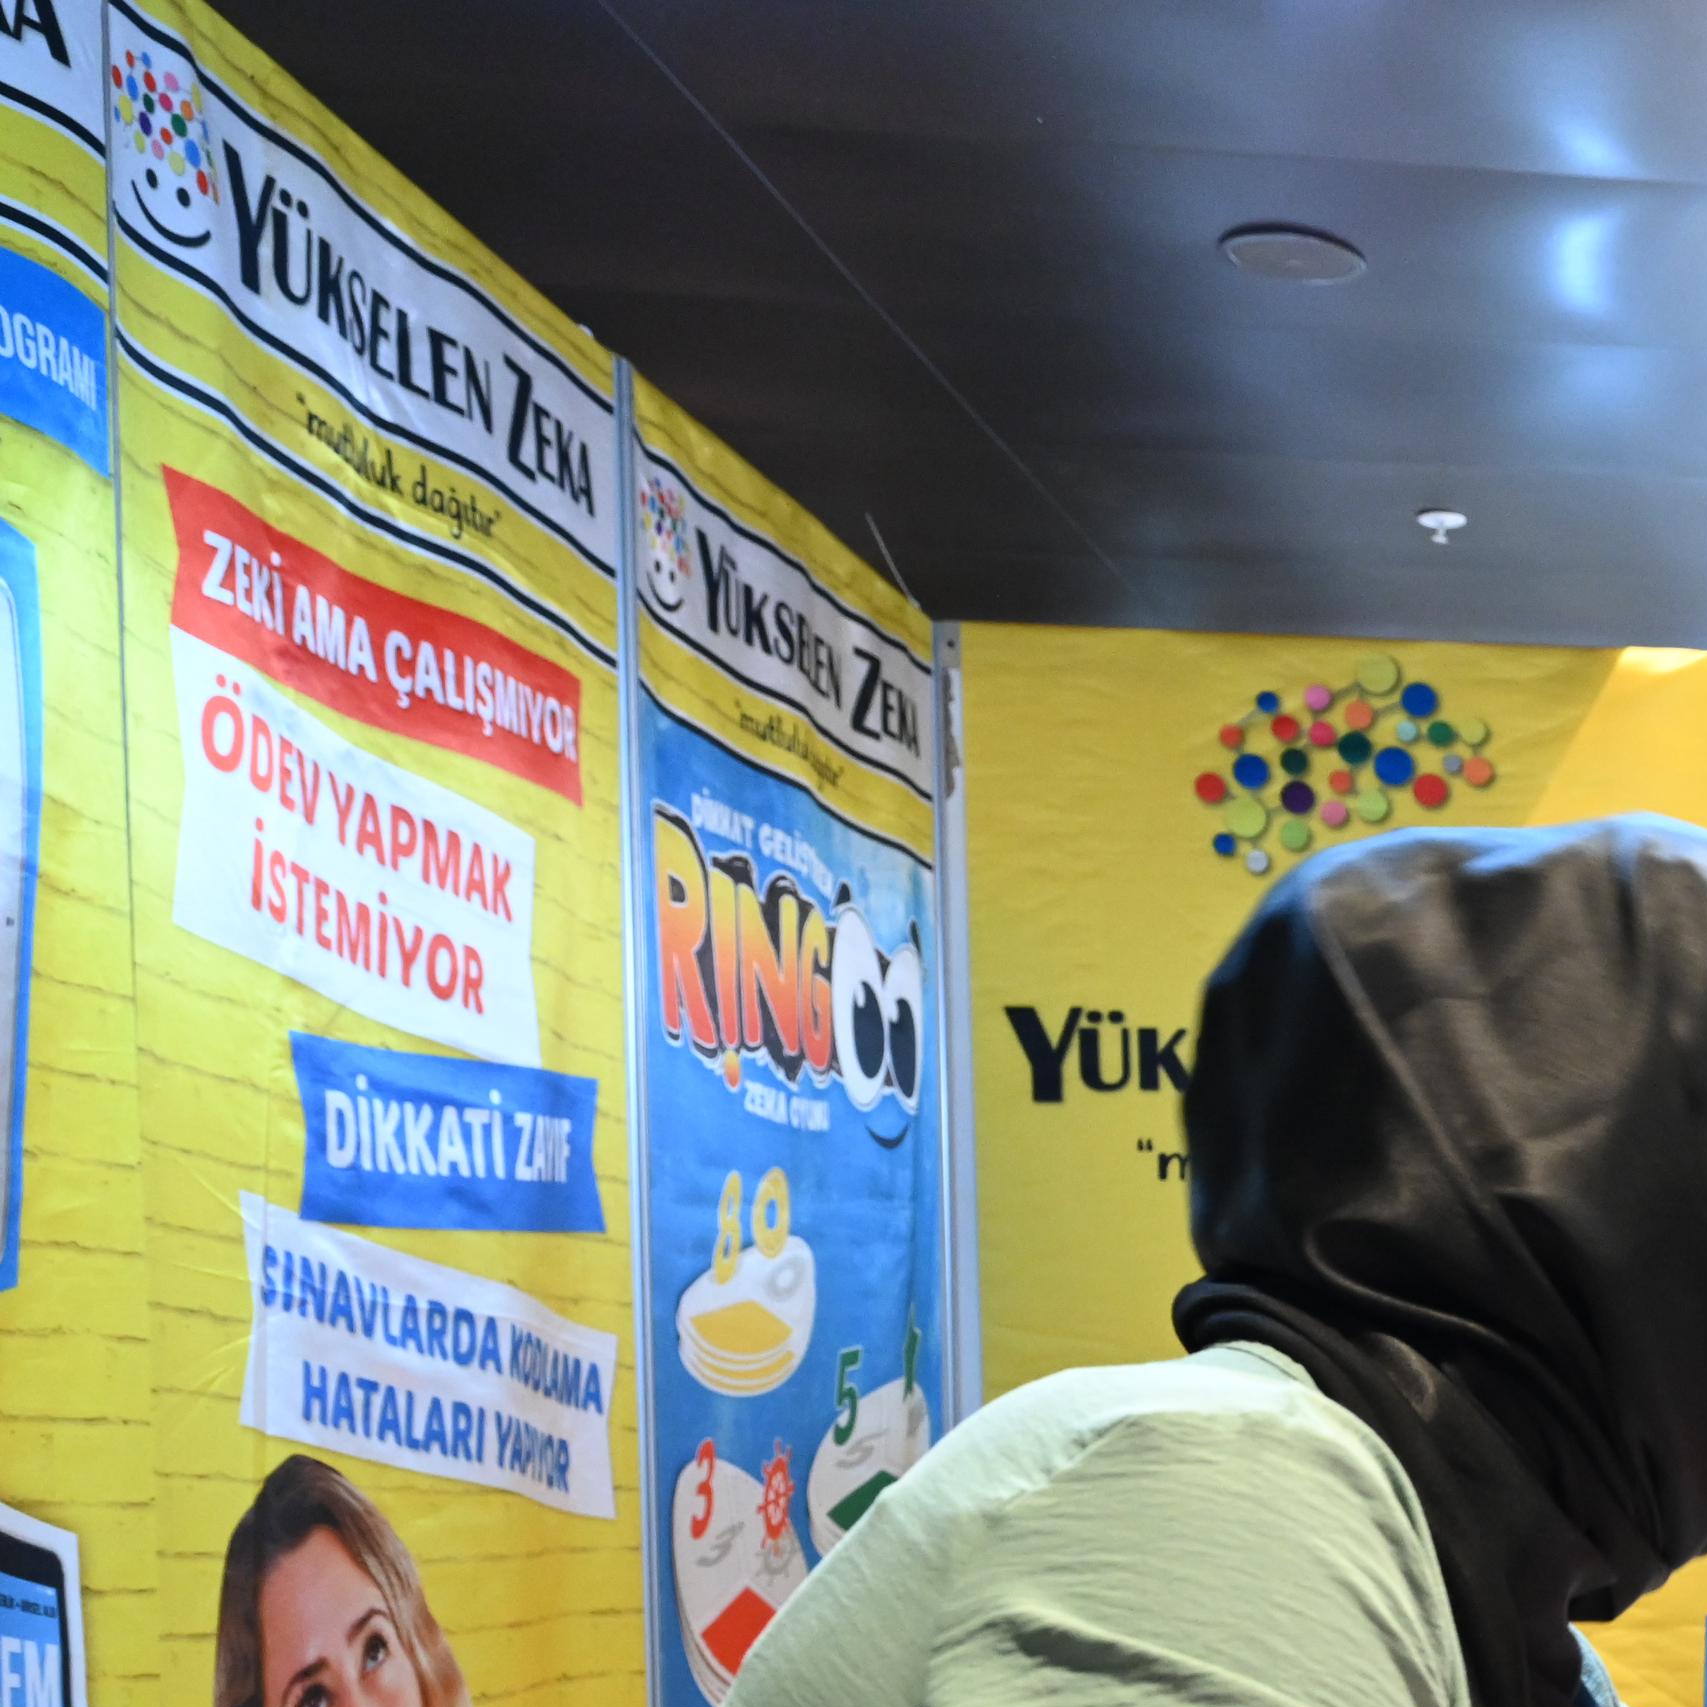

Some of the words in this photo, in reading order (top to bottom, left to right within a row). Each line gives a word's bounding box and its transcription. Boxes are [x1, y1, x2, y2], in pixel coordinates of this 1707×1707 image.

[221, 138, 492, 435] YÜKSELEN
[503, 354, 597, 518] ZEKA
[201, 528, 284, 637] ZEKİ
[293, 583, 377, 684] AMA
[384, 630, 578, 764] ÇALIŞMIYOR
[200, 673, 320, 827] ÖDEV
[327, 770, 513, 923] YAPMAK
[249, 817, 485, 1016] İSTEMİYOR
[324, 1073, 506, 1180] DİKKATİ
[260, 1244, 503, 1376] SINAVLARDA
[301, 1360, 486, 1464] HATALARI
